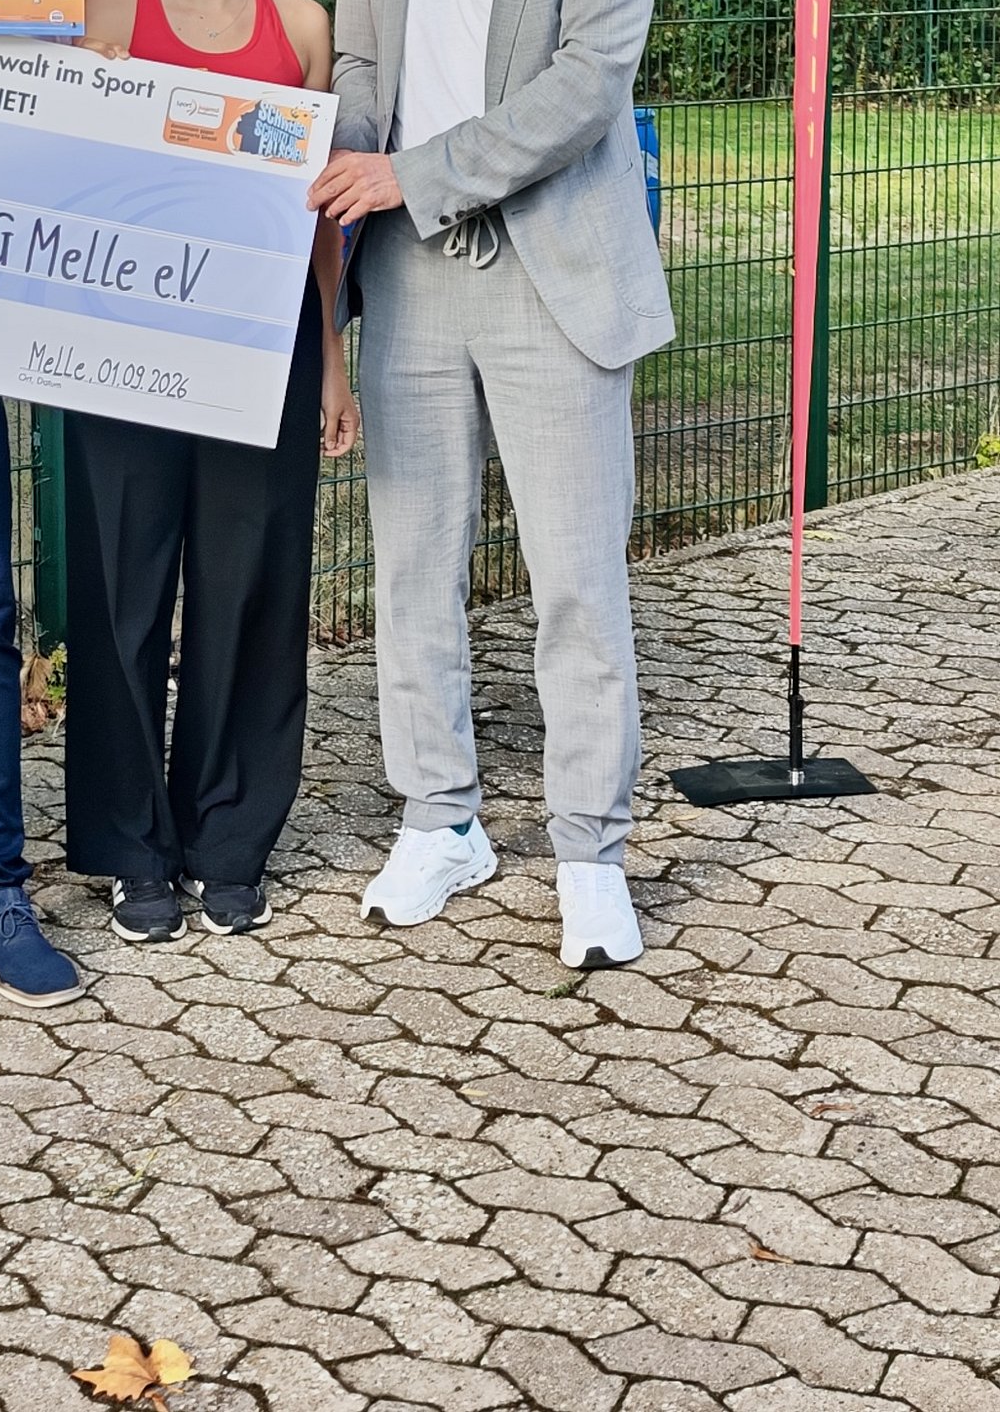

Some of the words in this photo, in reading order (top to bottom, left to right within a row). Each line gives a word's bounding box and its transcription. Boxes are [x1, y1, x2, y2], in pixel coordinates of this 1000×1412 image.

[55, 60, 83, 85] im
[91, 67, 156, 99] Sport
[25, 217, 137, 291] Melle
[154, 243, 211, 303] e.V.
